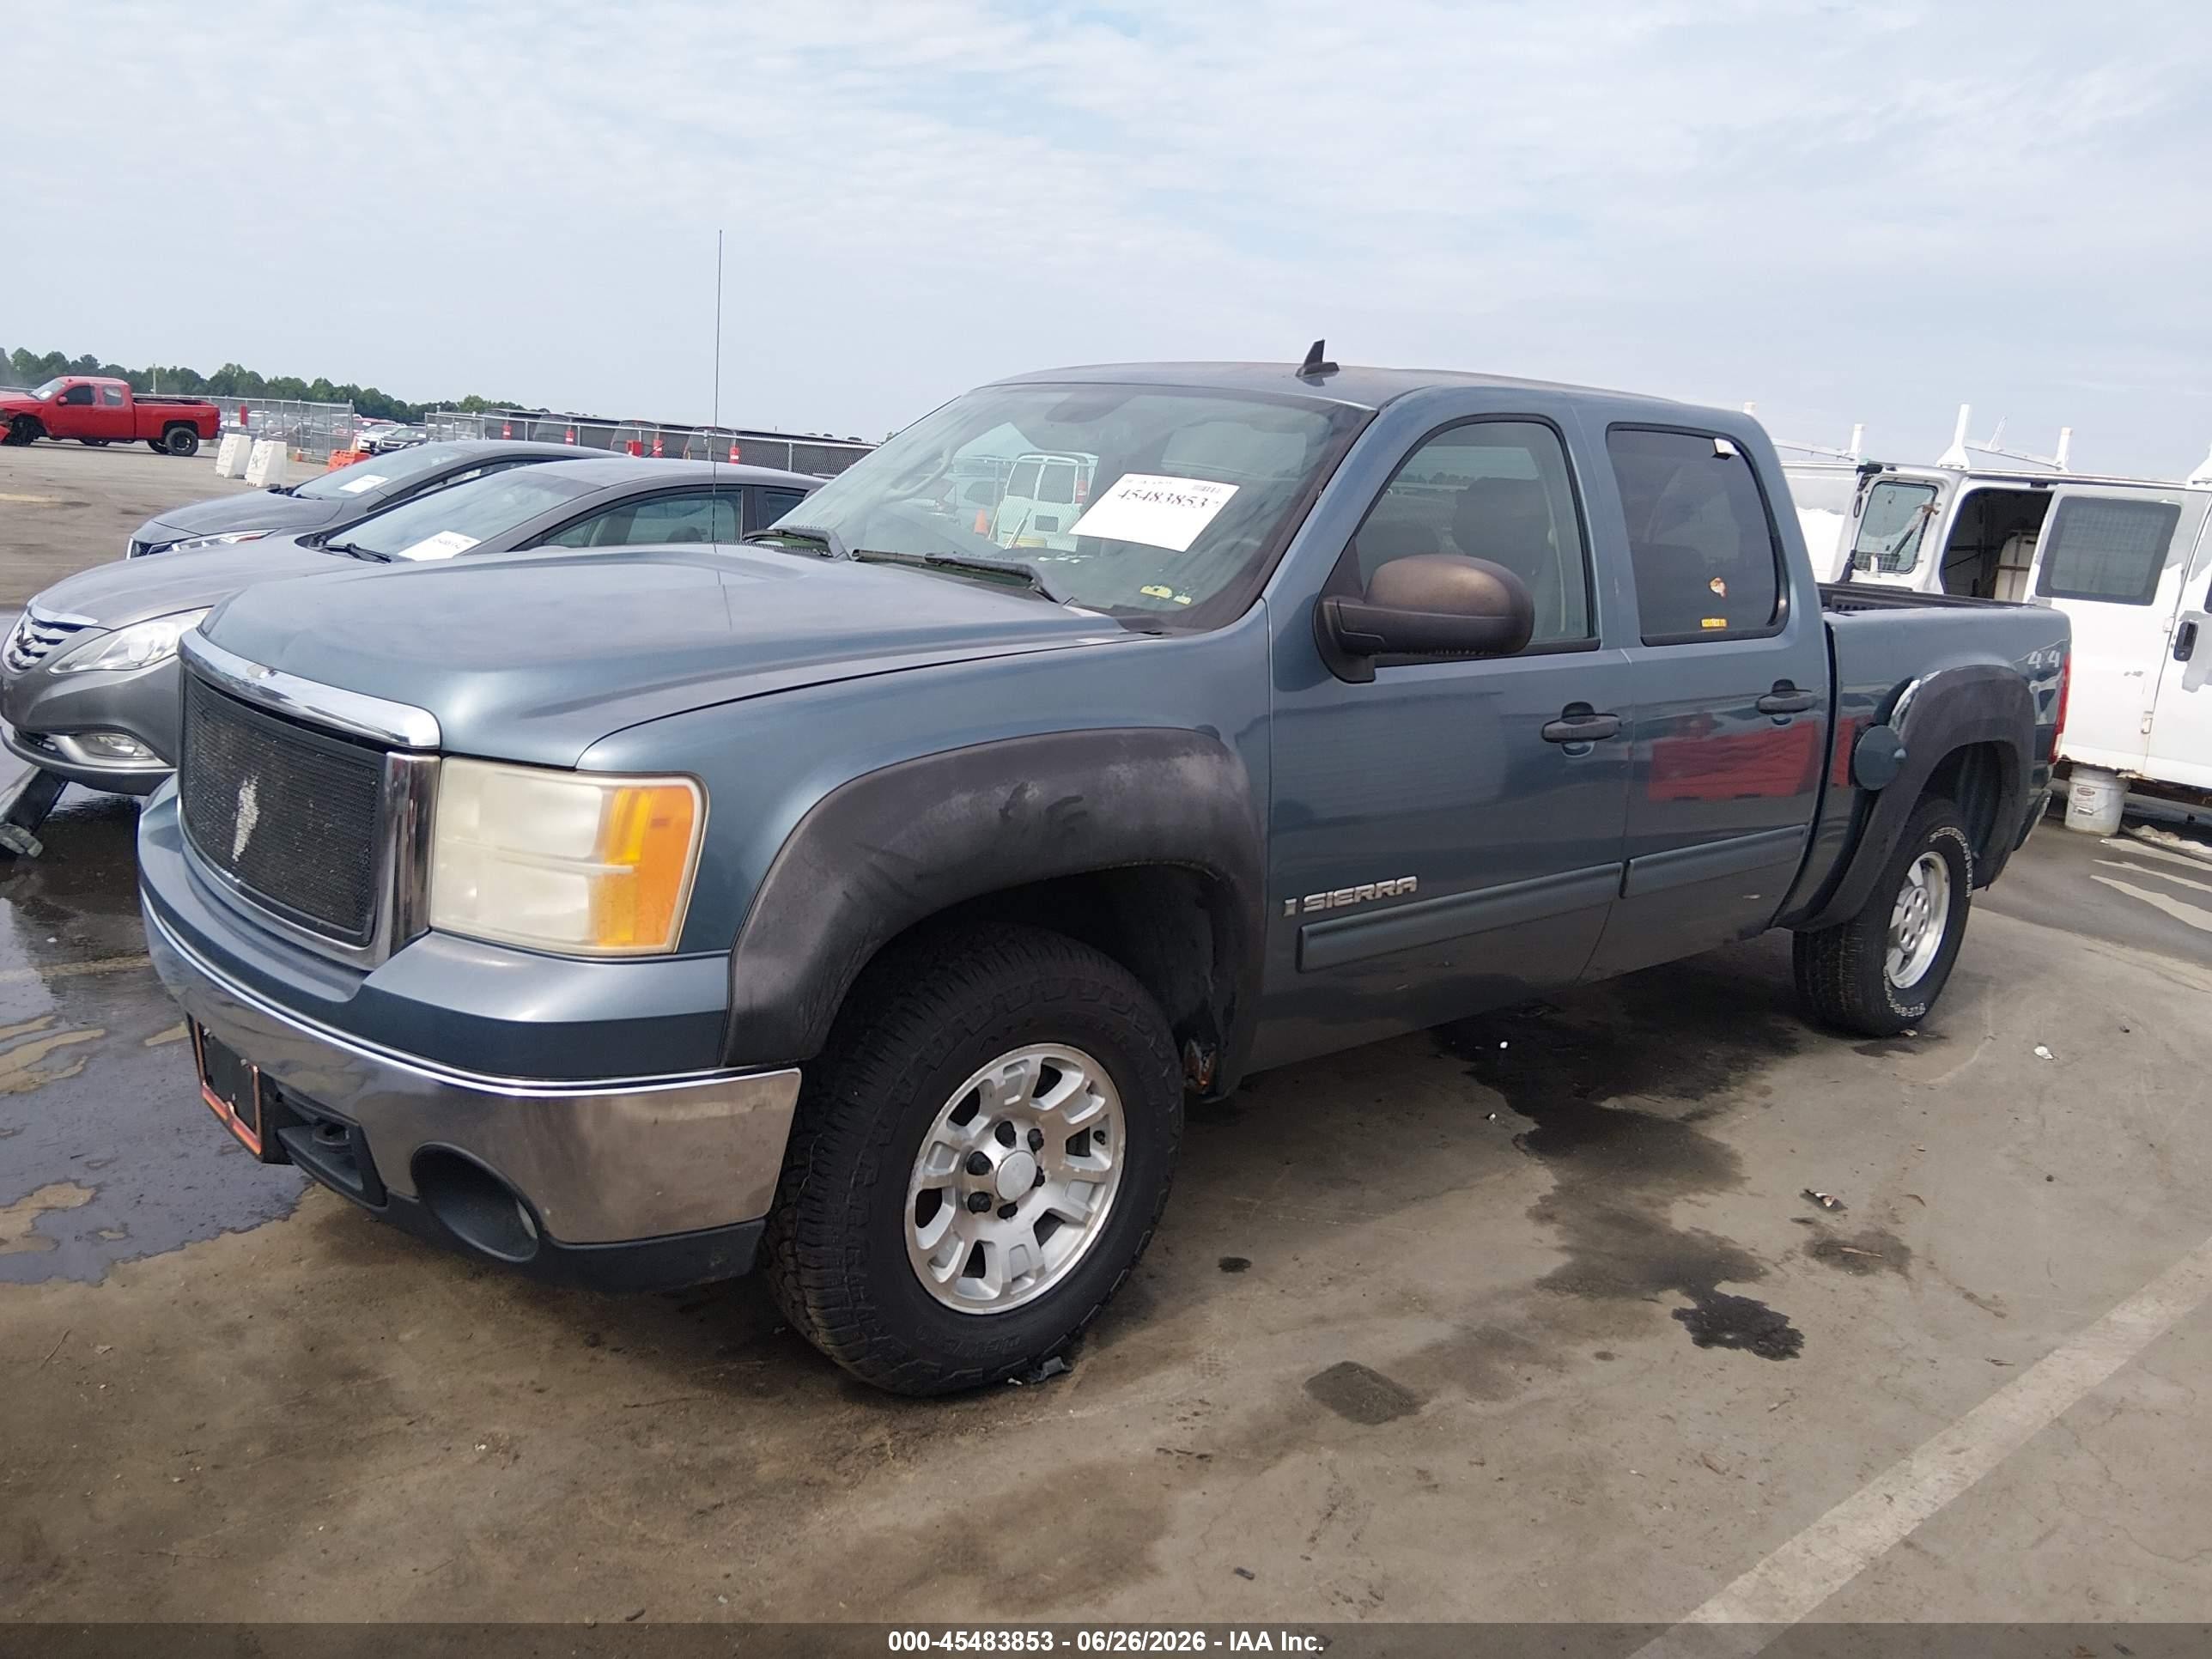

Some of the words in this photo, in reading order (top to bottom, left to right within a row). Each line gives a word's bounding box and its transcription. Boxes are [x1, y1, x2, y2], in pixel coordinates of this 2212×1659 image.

[1117, 489, 1208, 508] 45483853
[2027, 650, 2061, 669] 44
[1303, 876, 1417, 913] SIERRA
